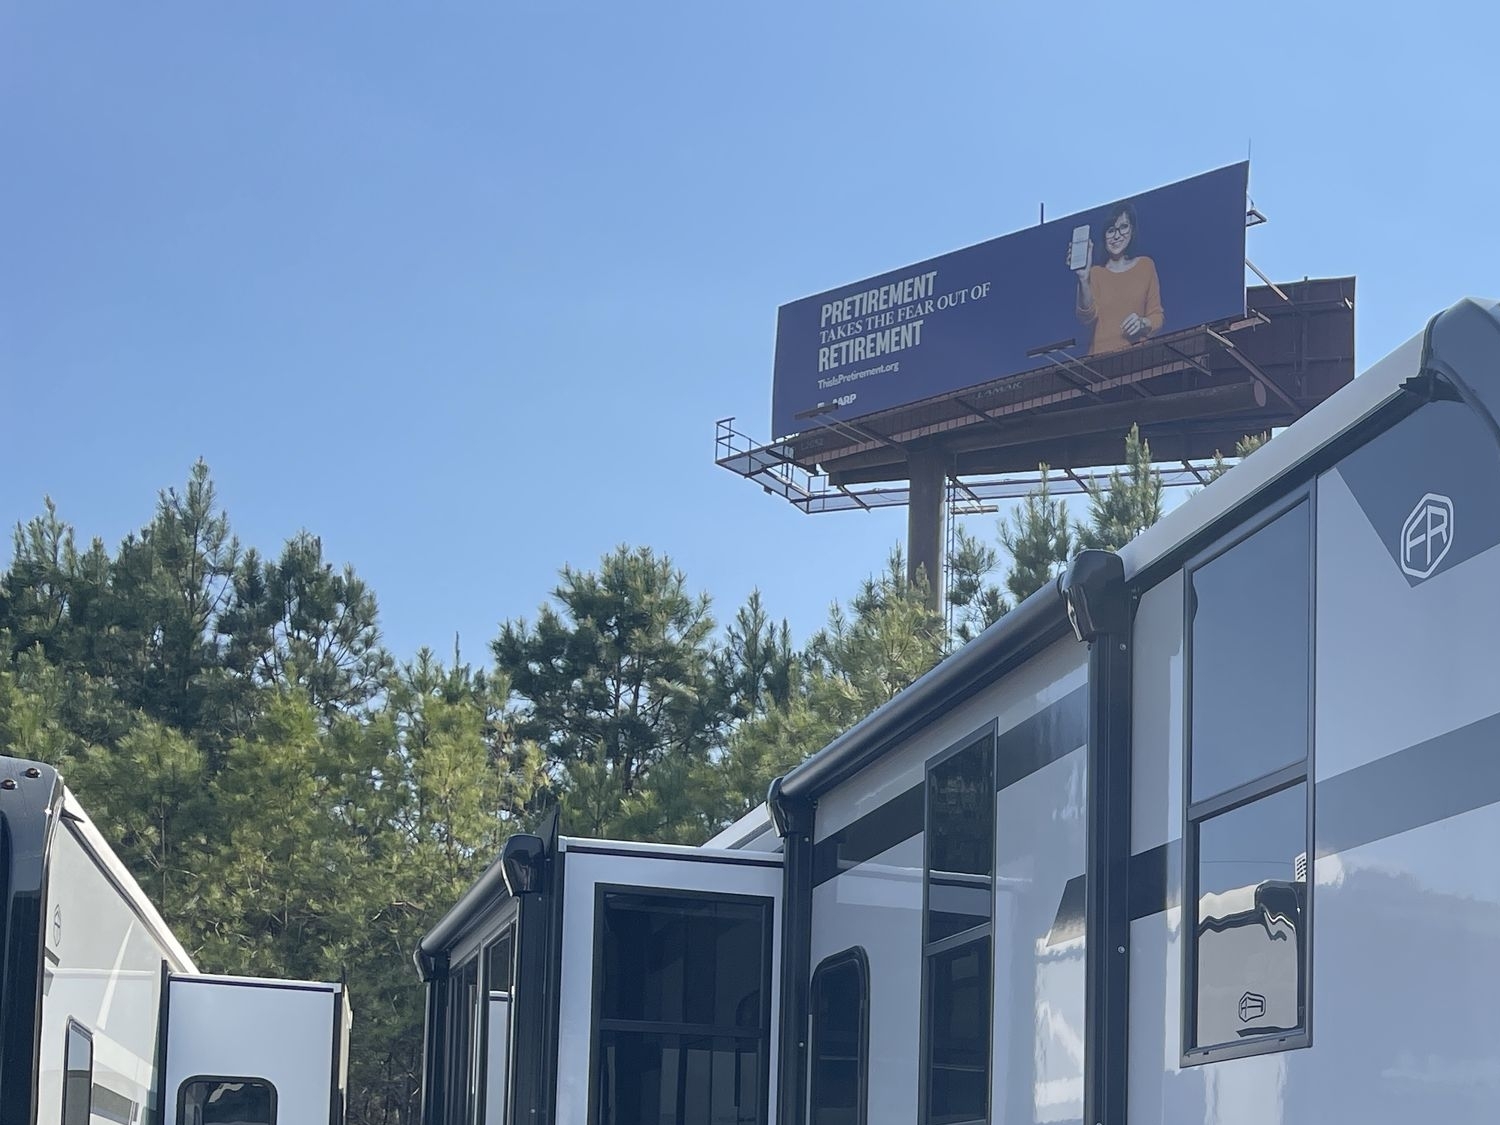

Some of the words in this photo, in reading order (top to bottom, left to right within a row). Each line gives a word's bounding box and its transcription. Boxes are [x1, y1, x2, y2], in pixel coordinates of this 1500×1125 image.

[820, 320, 862, 344] TAKES
[865, 311, 894, 331] THE
[898, 300, 935, 322] FEAR
[937, 289, 968, 310] OUT
[971, 282, 991, 300] OF
[821, 271, 938, 328] PRETIREMENT
[819, 320, 924, 372] RETIREMENT
